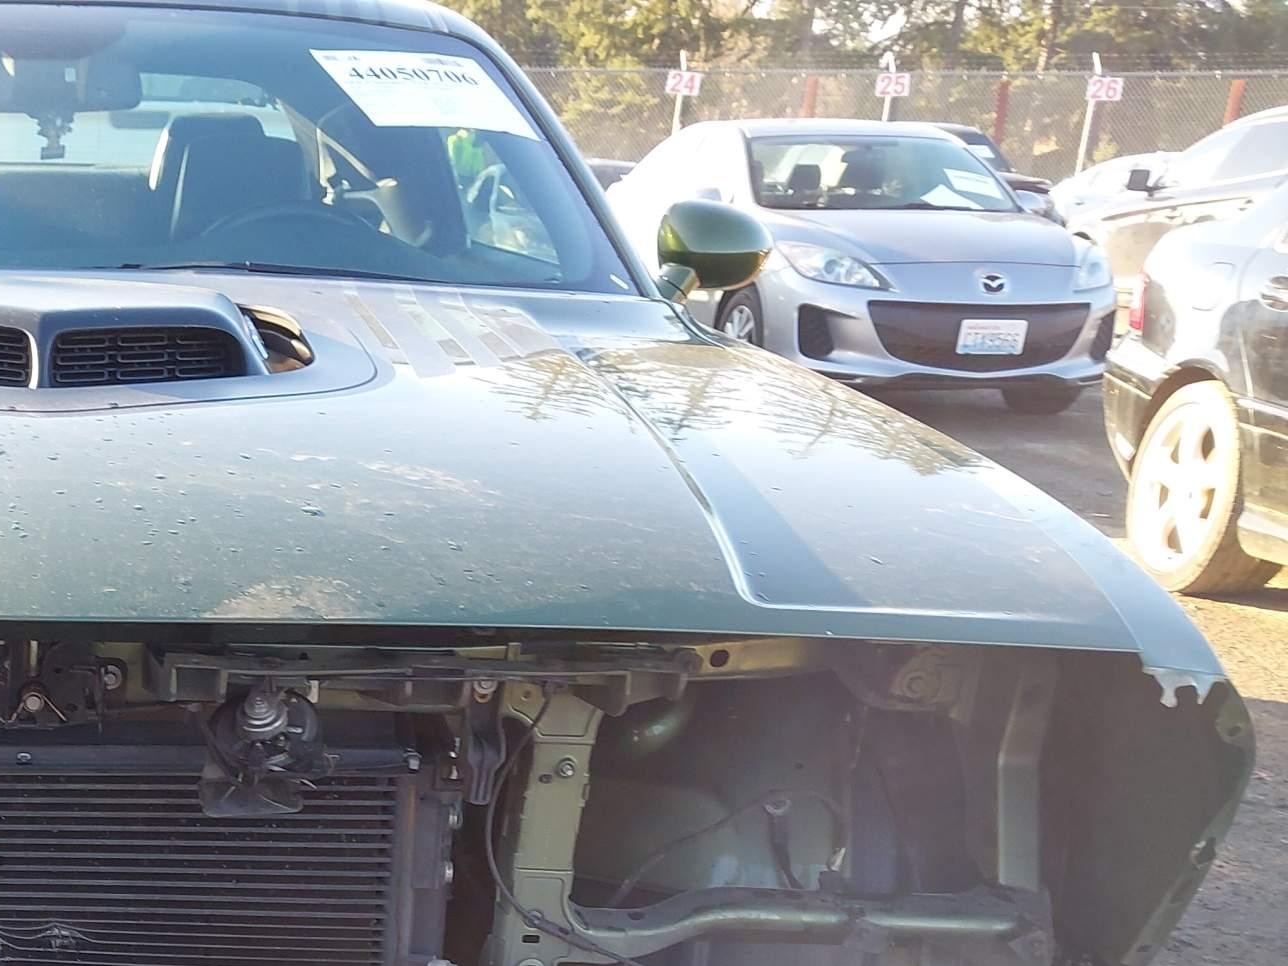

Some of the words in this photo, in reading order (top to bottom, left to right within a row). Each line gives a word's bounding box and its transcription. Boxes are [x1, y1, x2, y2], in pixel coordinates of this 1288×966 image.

[348, 66, 479, 86] 44050706
[669, 72, 696, 94] 24
[879, 74, 906, 96] 25
[1090, 78, 1119, 99] 26
